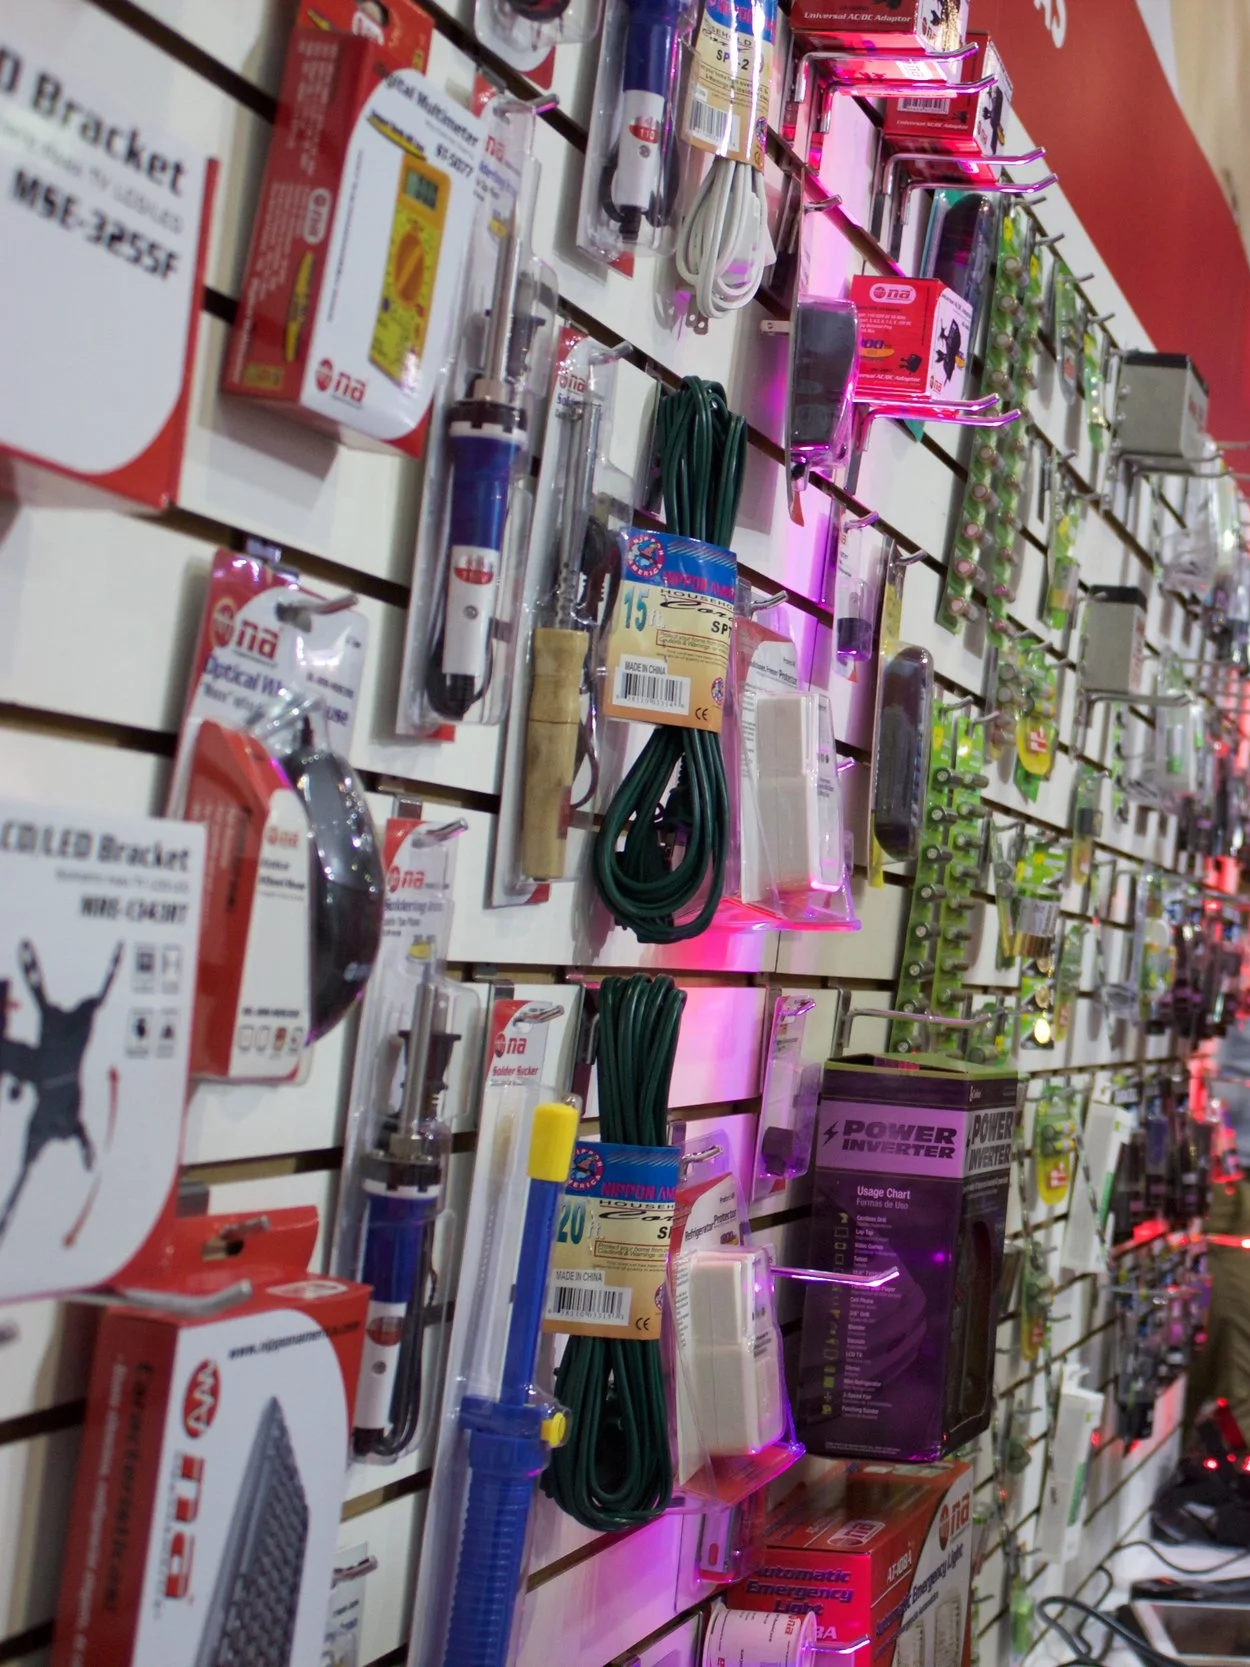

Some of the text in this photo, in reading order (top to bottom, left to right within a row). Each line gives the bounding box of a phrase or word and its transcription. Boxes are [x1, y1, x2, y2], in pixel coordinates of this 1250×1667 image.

[804, 12, 912, 23] Universal AC/DC Adaptor
[417, 90, 480, 147] Multimeter
[32, 70, 185, 198] Bracket
[623, 588, 650, 632] 15
[624, 661, 641, 673] MADE
[648, 664, 666, 675] CHINA
[97, 833, 190, 873] Bracket
[492, 1066, 539, 1076] Solder Sucker
[842, 1119, 958, 1145] POWER
[971, 1111, 1014, 1145] POWER
[842, 1138, 956, 1160] INVERTER
[968, 1143, 1012, 1171] INVERTER
[601, 1182, 655, 1200] NIPPON
[857, 1186, 911, 1200] Usage Chart
[856, 1199, 909, 1210] Formas de Uso
[556, 1202, 587, 1244] 20
[685, 1223, 714, 1241] Refrigerator
[713, 1208, 737, 1226] Protector
[556, 1270, 602, 1281] MADE IN CHINA
[744, 1579, 855, 1603] Emergency
